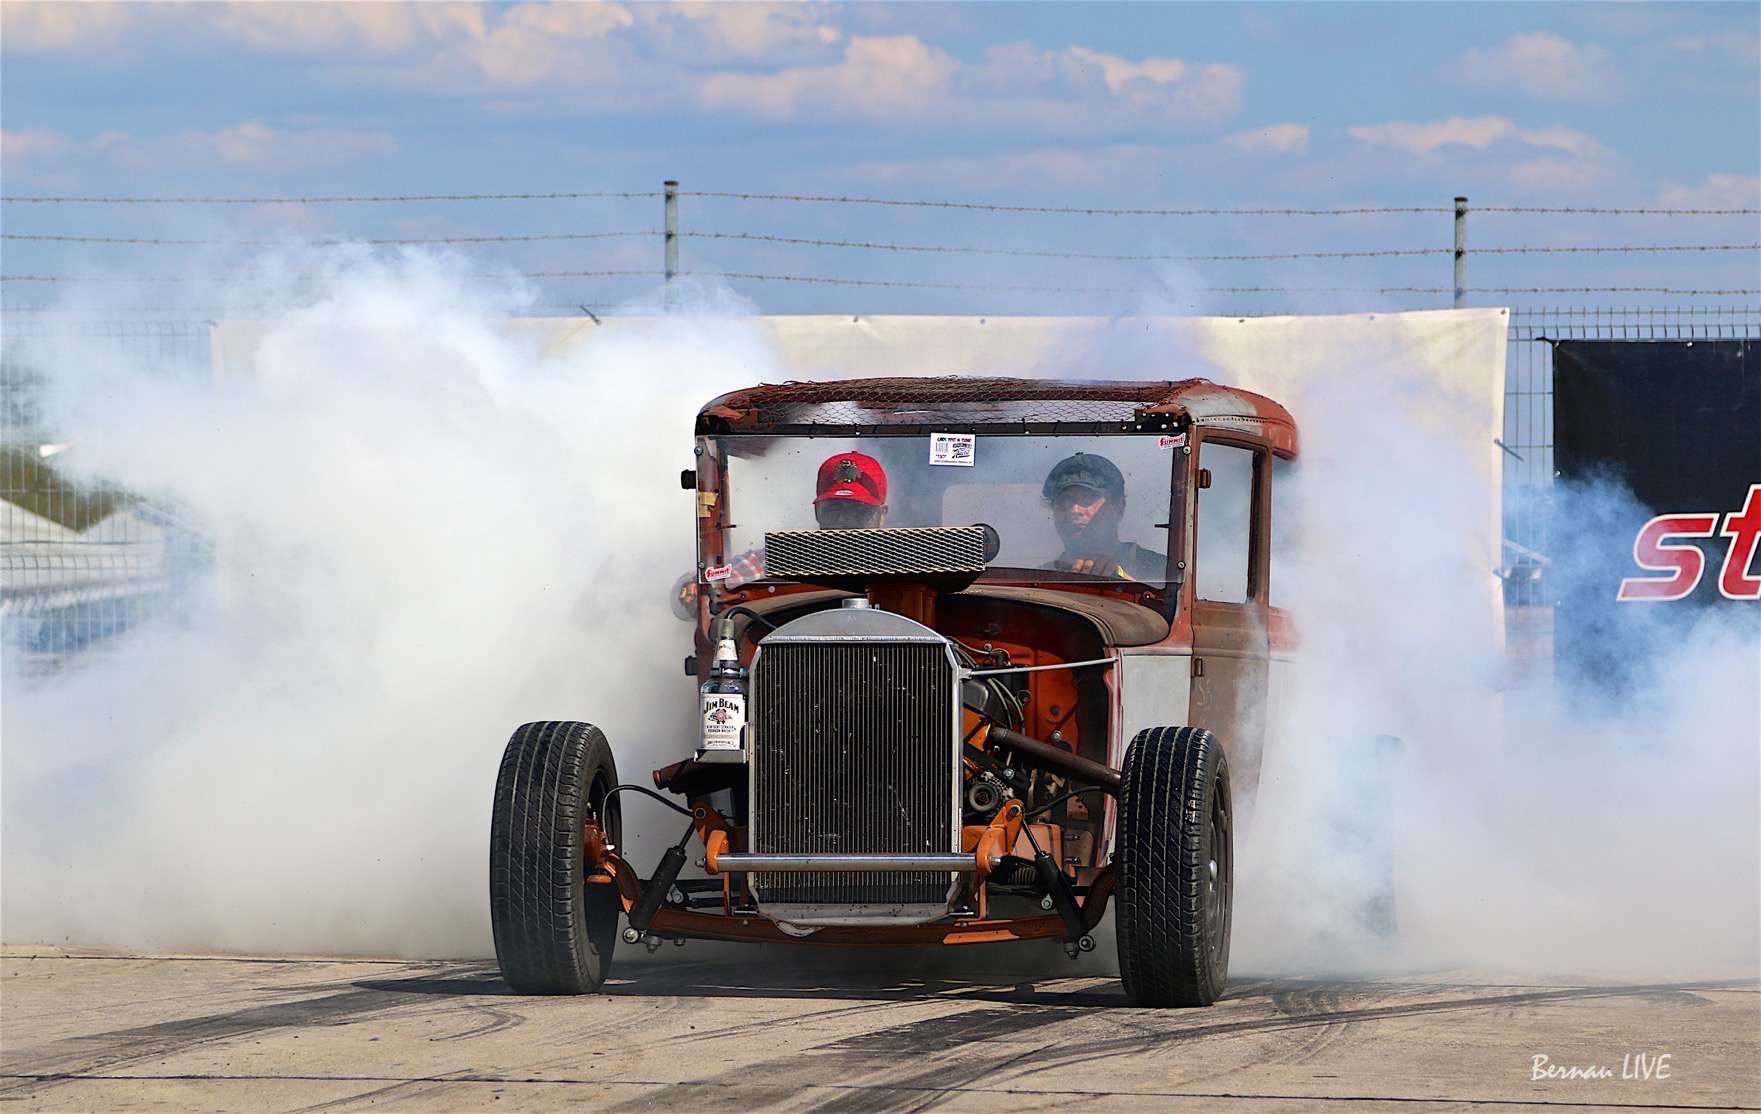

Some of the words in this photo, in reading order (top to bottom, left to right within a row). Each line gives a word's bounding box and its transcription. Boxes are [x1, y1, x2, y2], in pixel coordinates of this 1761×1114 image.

[1616, 484, 1761, 602] st
[704, 700, 718, 714] JIM
[719, 698, 739, 714] BEAM
